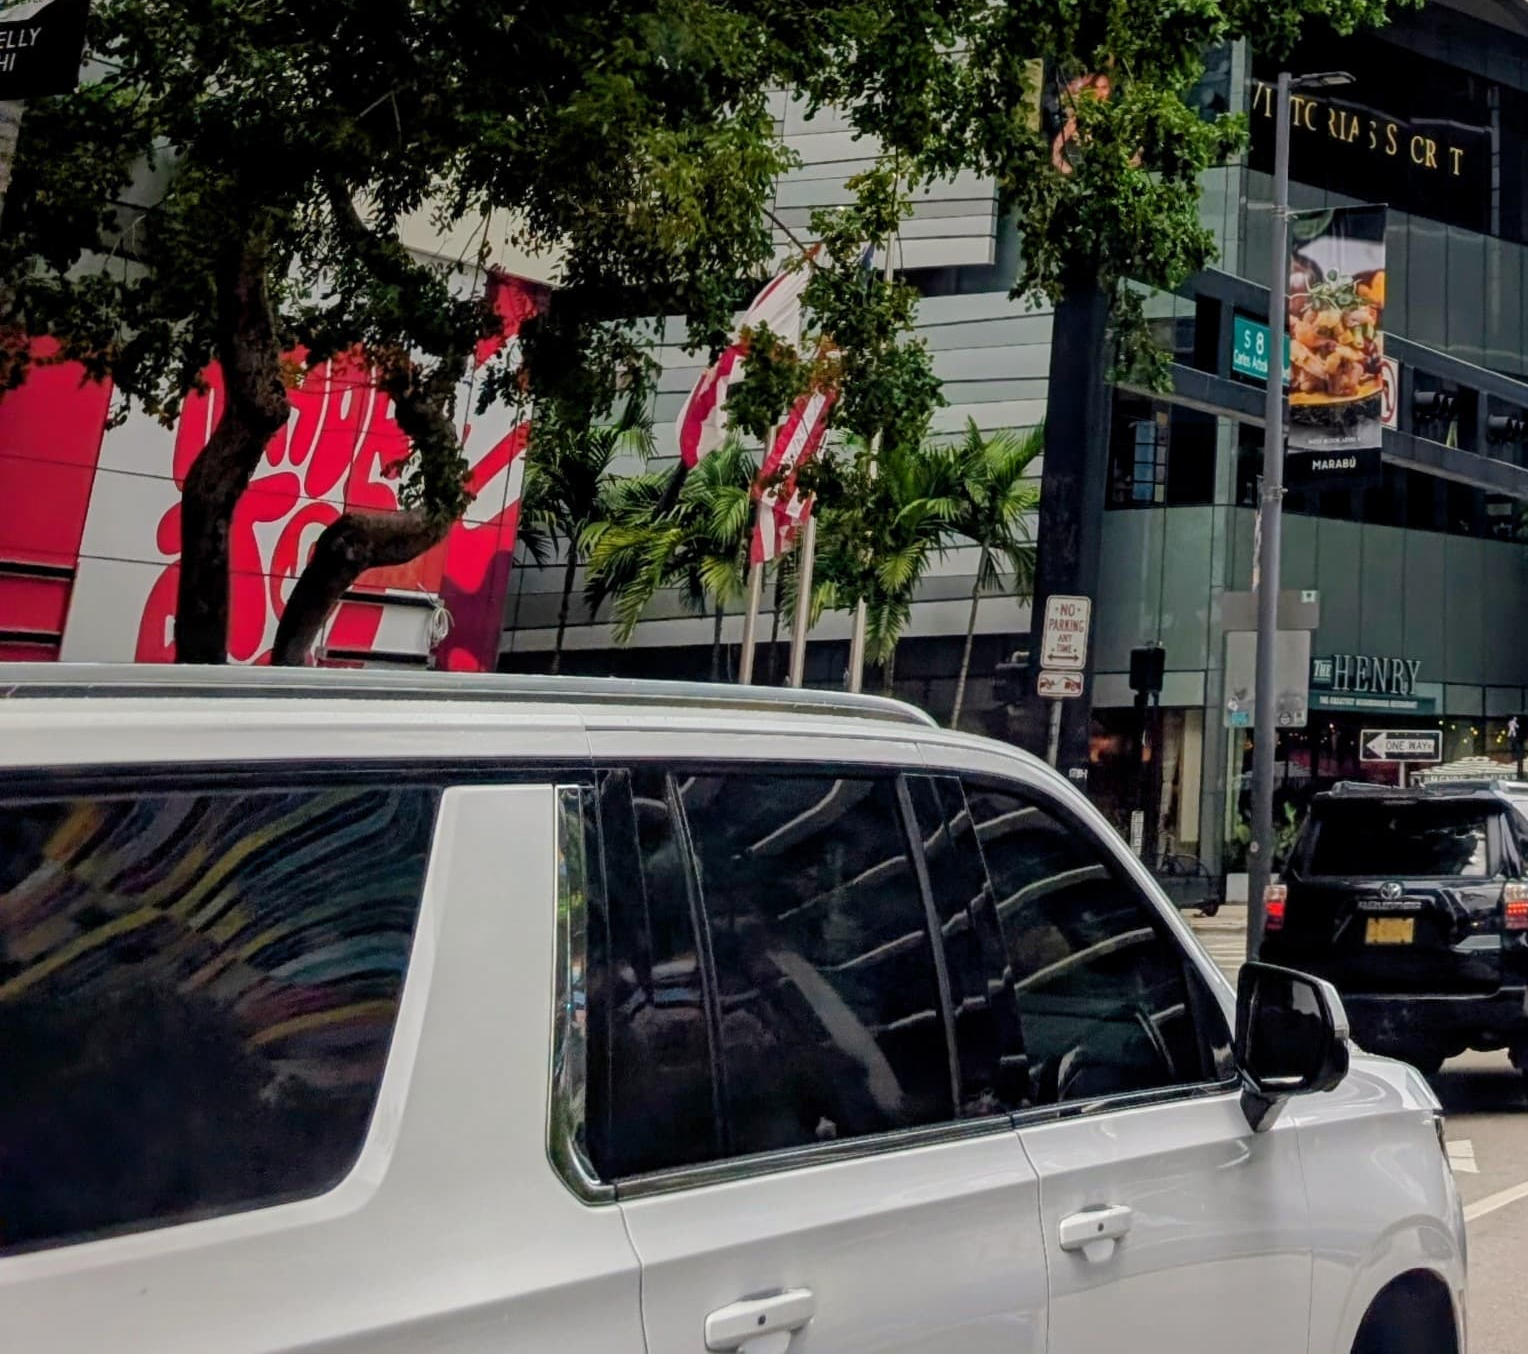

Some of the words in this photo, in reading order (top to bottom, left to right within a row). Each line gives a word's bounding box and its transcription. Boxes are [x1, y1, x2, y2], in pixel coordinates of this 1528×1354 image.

[1243, 329, 1252, 350] S
[1255, 331, 1265, 356] 8
[1311, 455, 1357, 471] MARABÚ
[1060, 603, 1076, 617] NO
[1048, 618, 1085, 633] PARKING
[1057, 634, 1073, 643] ANY
[1056, 643, 1072, 654] TIME
[1313, 659, 1333, 678] THE
[1331, 654, 1421, 696] HENRY
[1385, 741, 1404, 751] ONE
[1408, 741, 1428, 751] WAY
